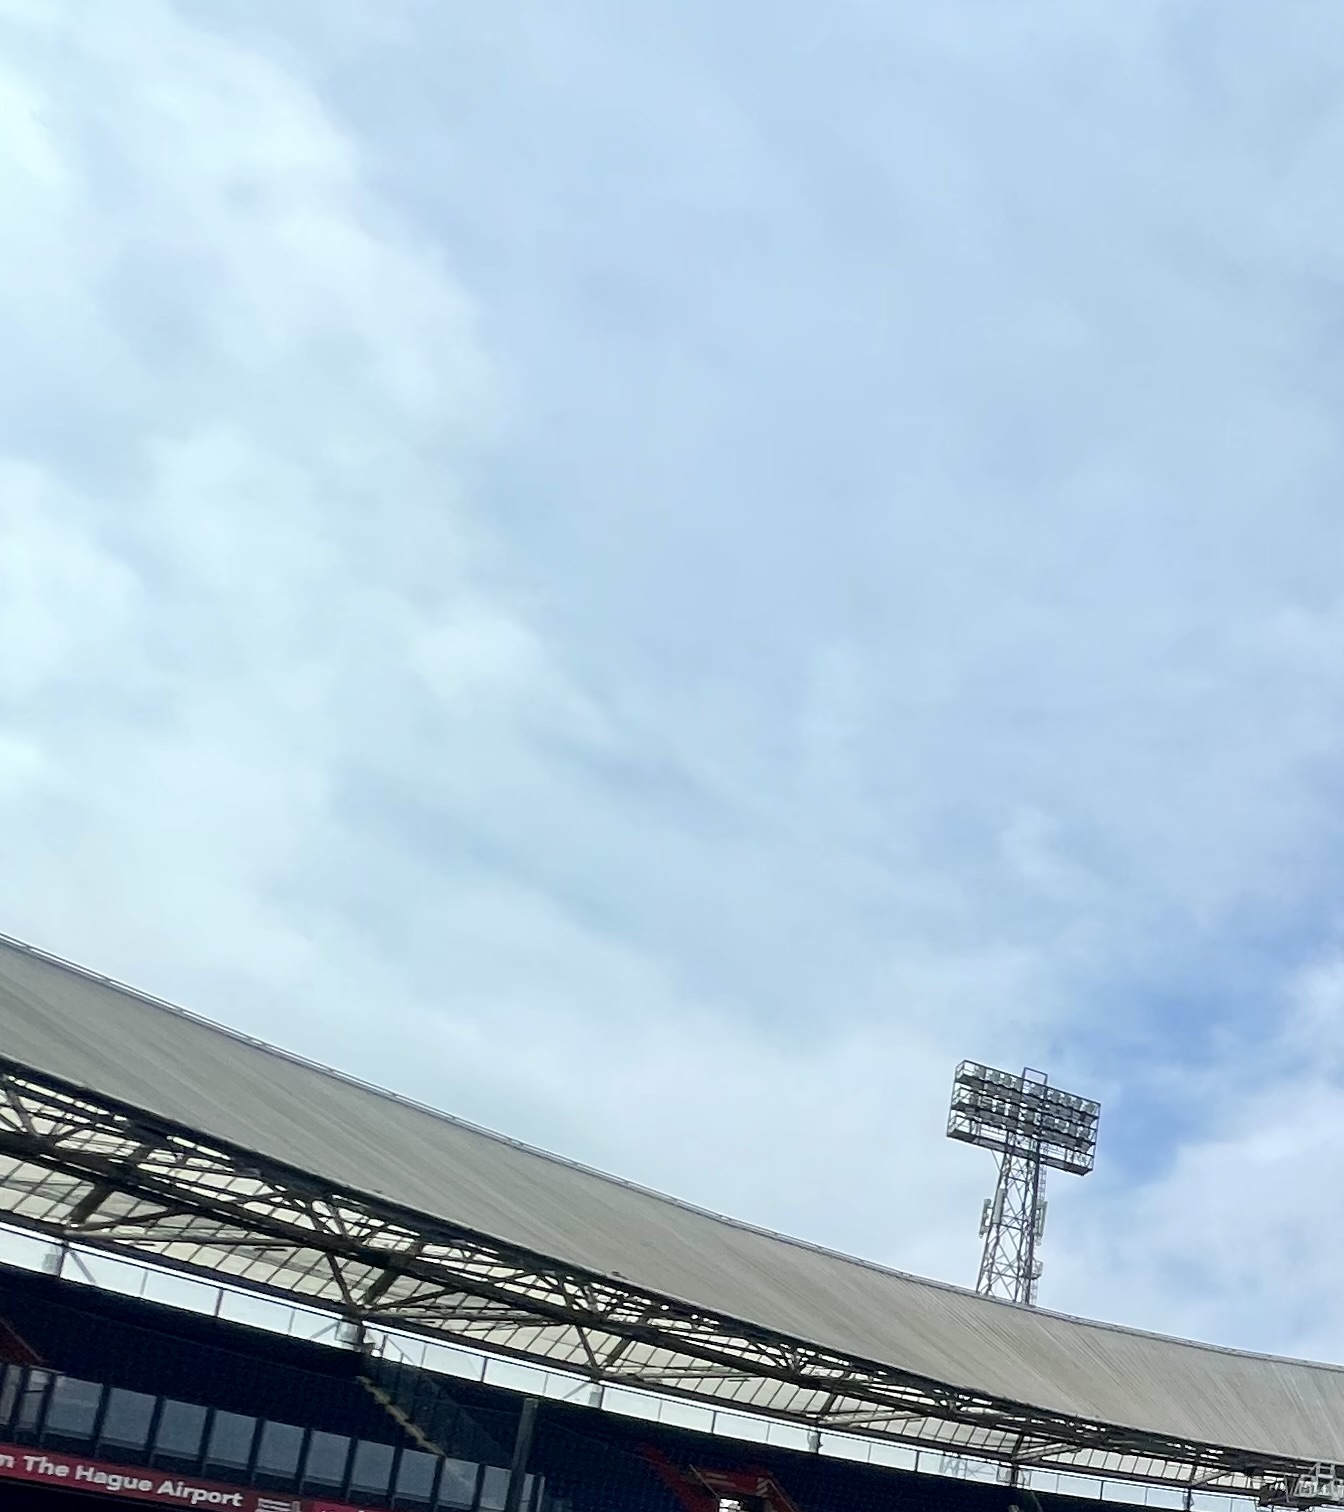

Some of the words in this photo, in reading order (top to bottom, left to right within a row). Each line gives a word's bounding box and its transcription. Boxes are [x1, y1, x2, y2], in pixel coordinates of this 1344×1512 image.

[24, 1455, 69, 1477] The
[75, 1465, 152, 1491] Hague
[157, 1480, 243, 1507] Airport
